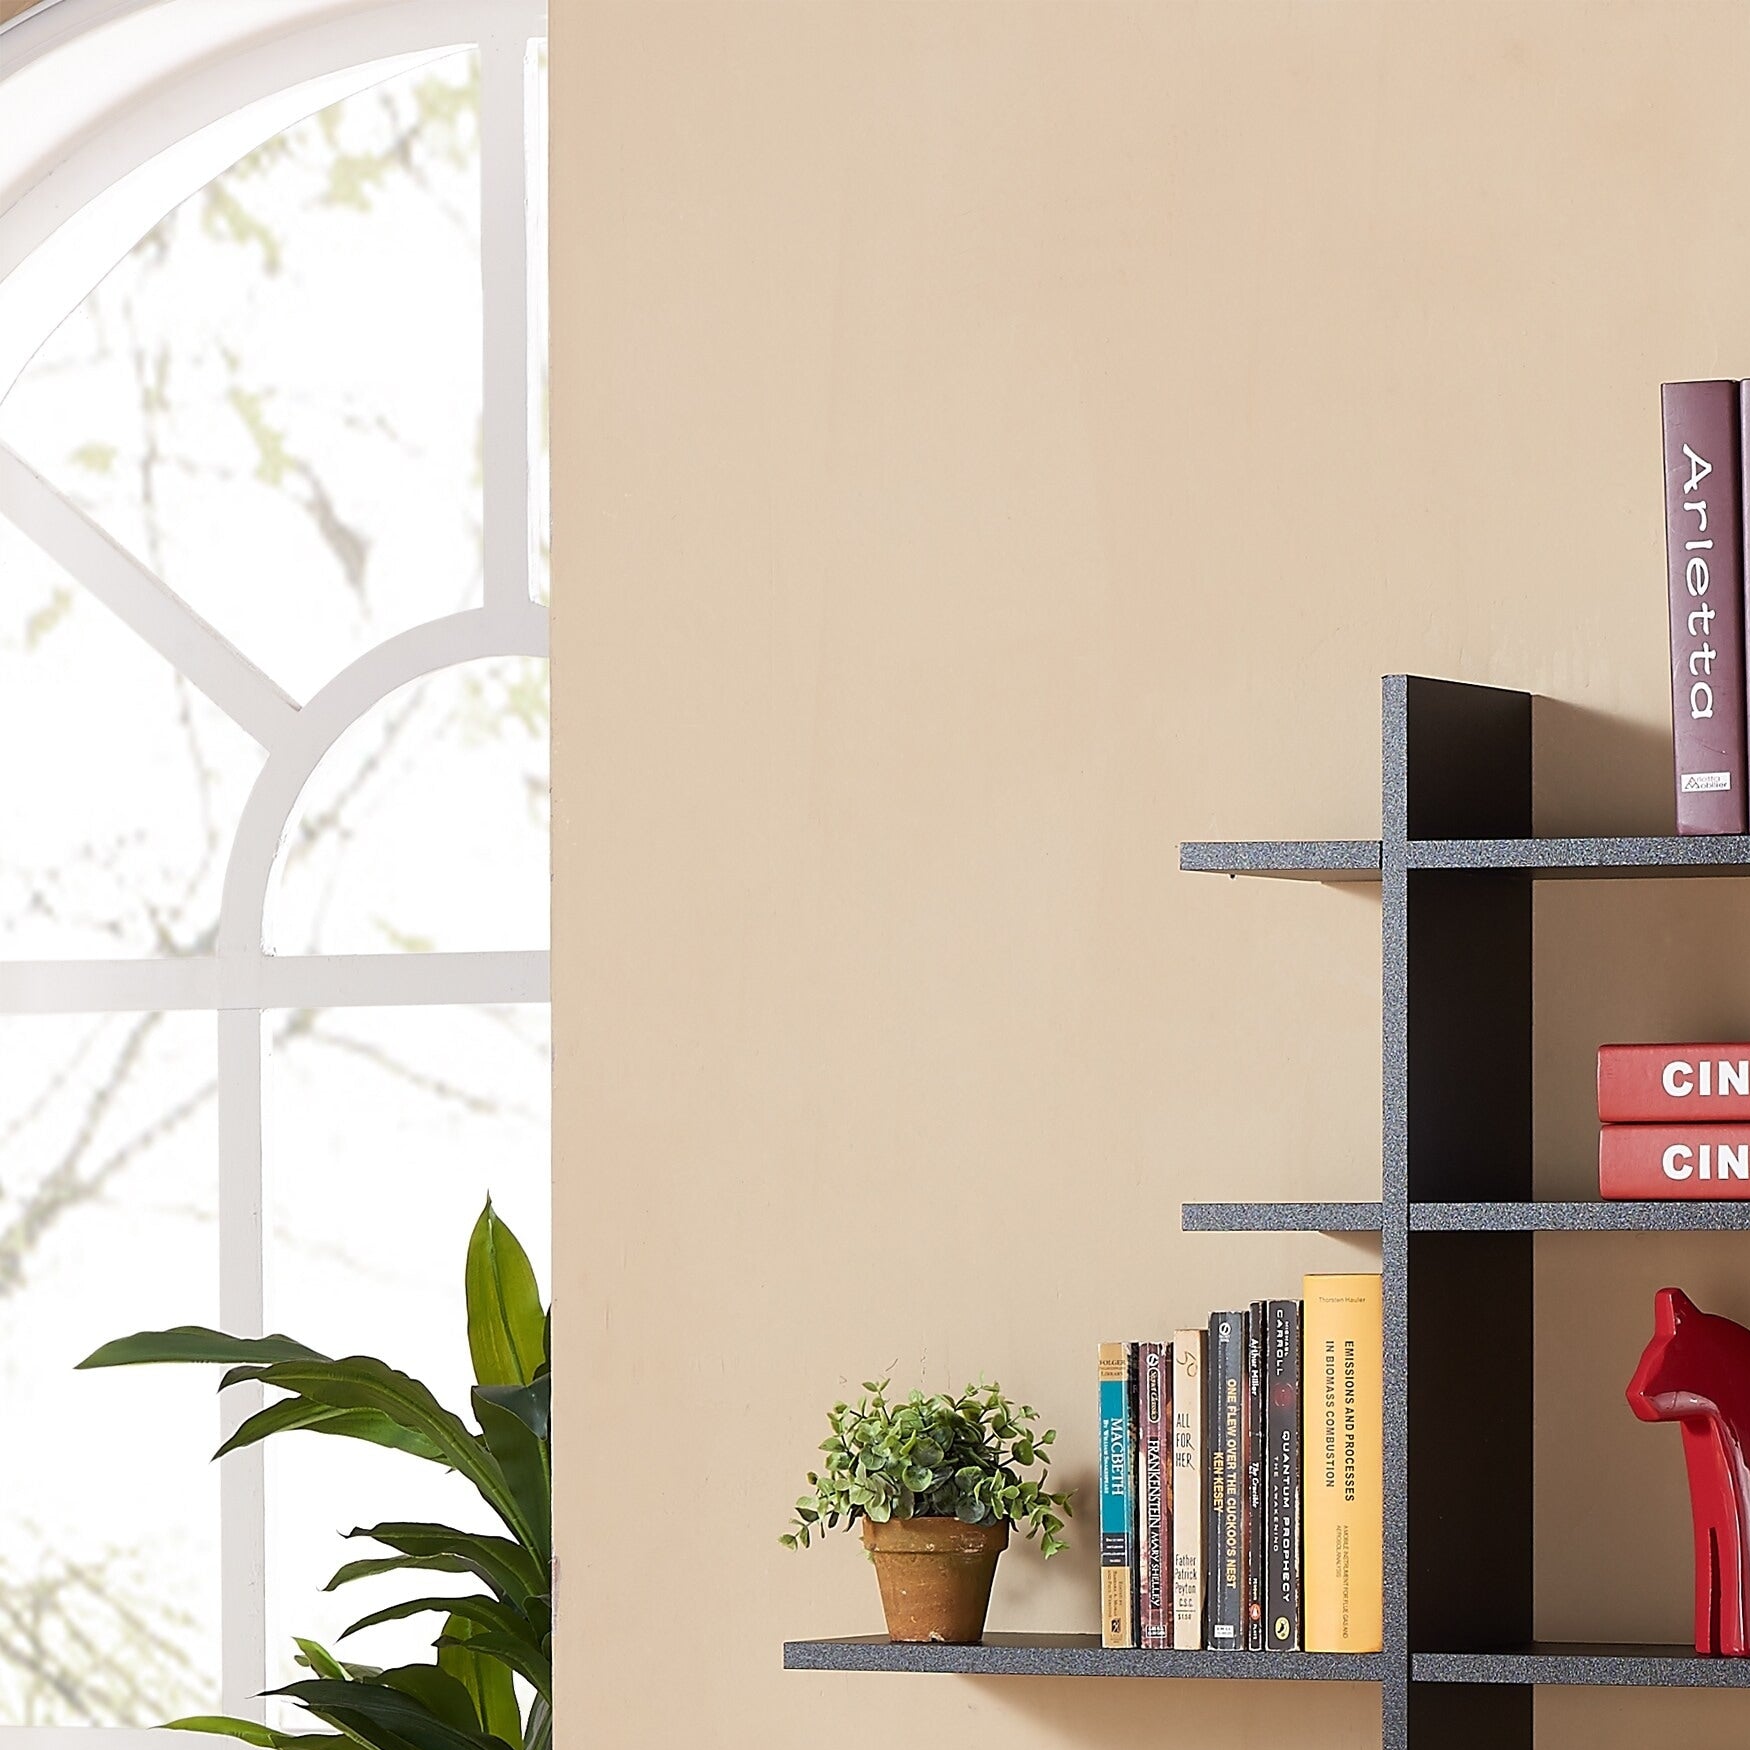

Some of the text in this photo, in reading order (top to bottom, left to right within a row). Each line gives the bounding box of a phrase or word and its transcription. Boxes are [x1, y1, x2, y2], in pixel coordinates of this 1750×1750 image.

[1682, 444, 1717, 719] Arletta
[1276, 1309, 1284, 1376] CARROLL
[1176, 1413, 1190, 1428] ALL
[1176, 1433, 1195, 1451] FOR
[1326, 1340, 1335, 1488] IN BIOMASS COMBUSTION
[1345, 1340, 1355, 1502] EMISSIONS AND PROCESSES
[1111, 1417, 1123, 1496] MACBETH
[1176, 1453, 1195, 1471] HER
[1213, 1451, 1224, 1513] KEN KESEY
[1227, 1379, 1237, 1589] ONE FLEW OVER THE CUCKOO'S NEST
[1148, 1439, 1161, 1607] FRANKENSTEIN MARY SHELLEY
[1282, 1430, 1291, 1602] QUANTUM PROPHECY
[1175, 1553, 1196, 1566] Father
[1175, 1568, 1197, 1580] Patrick
